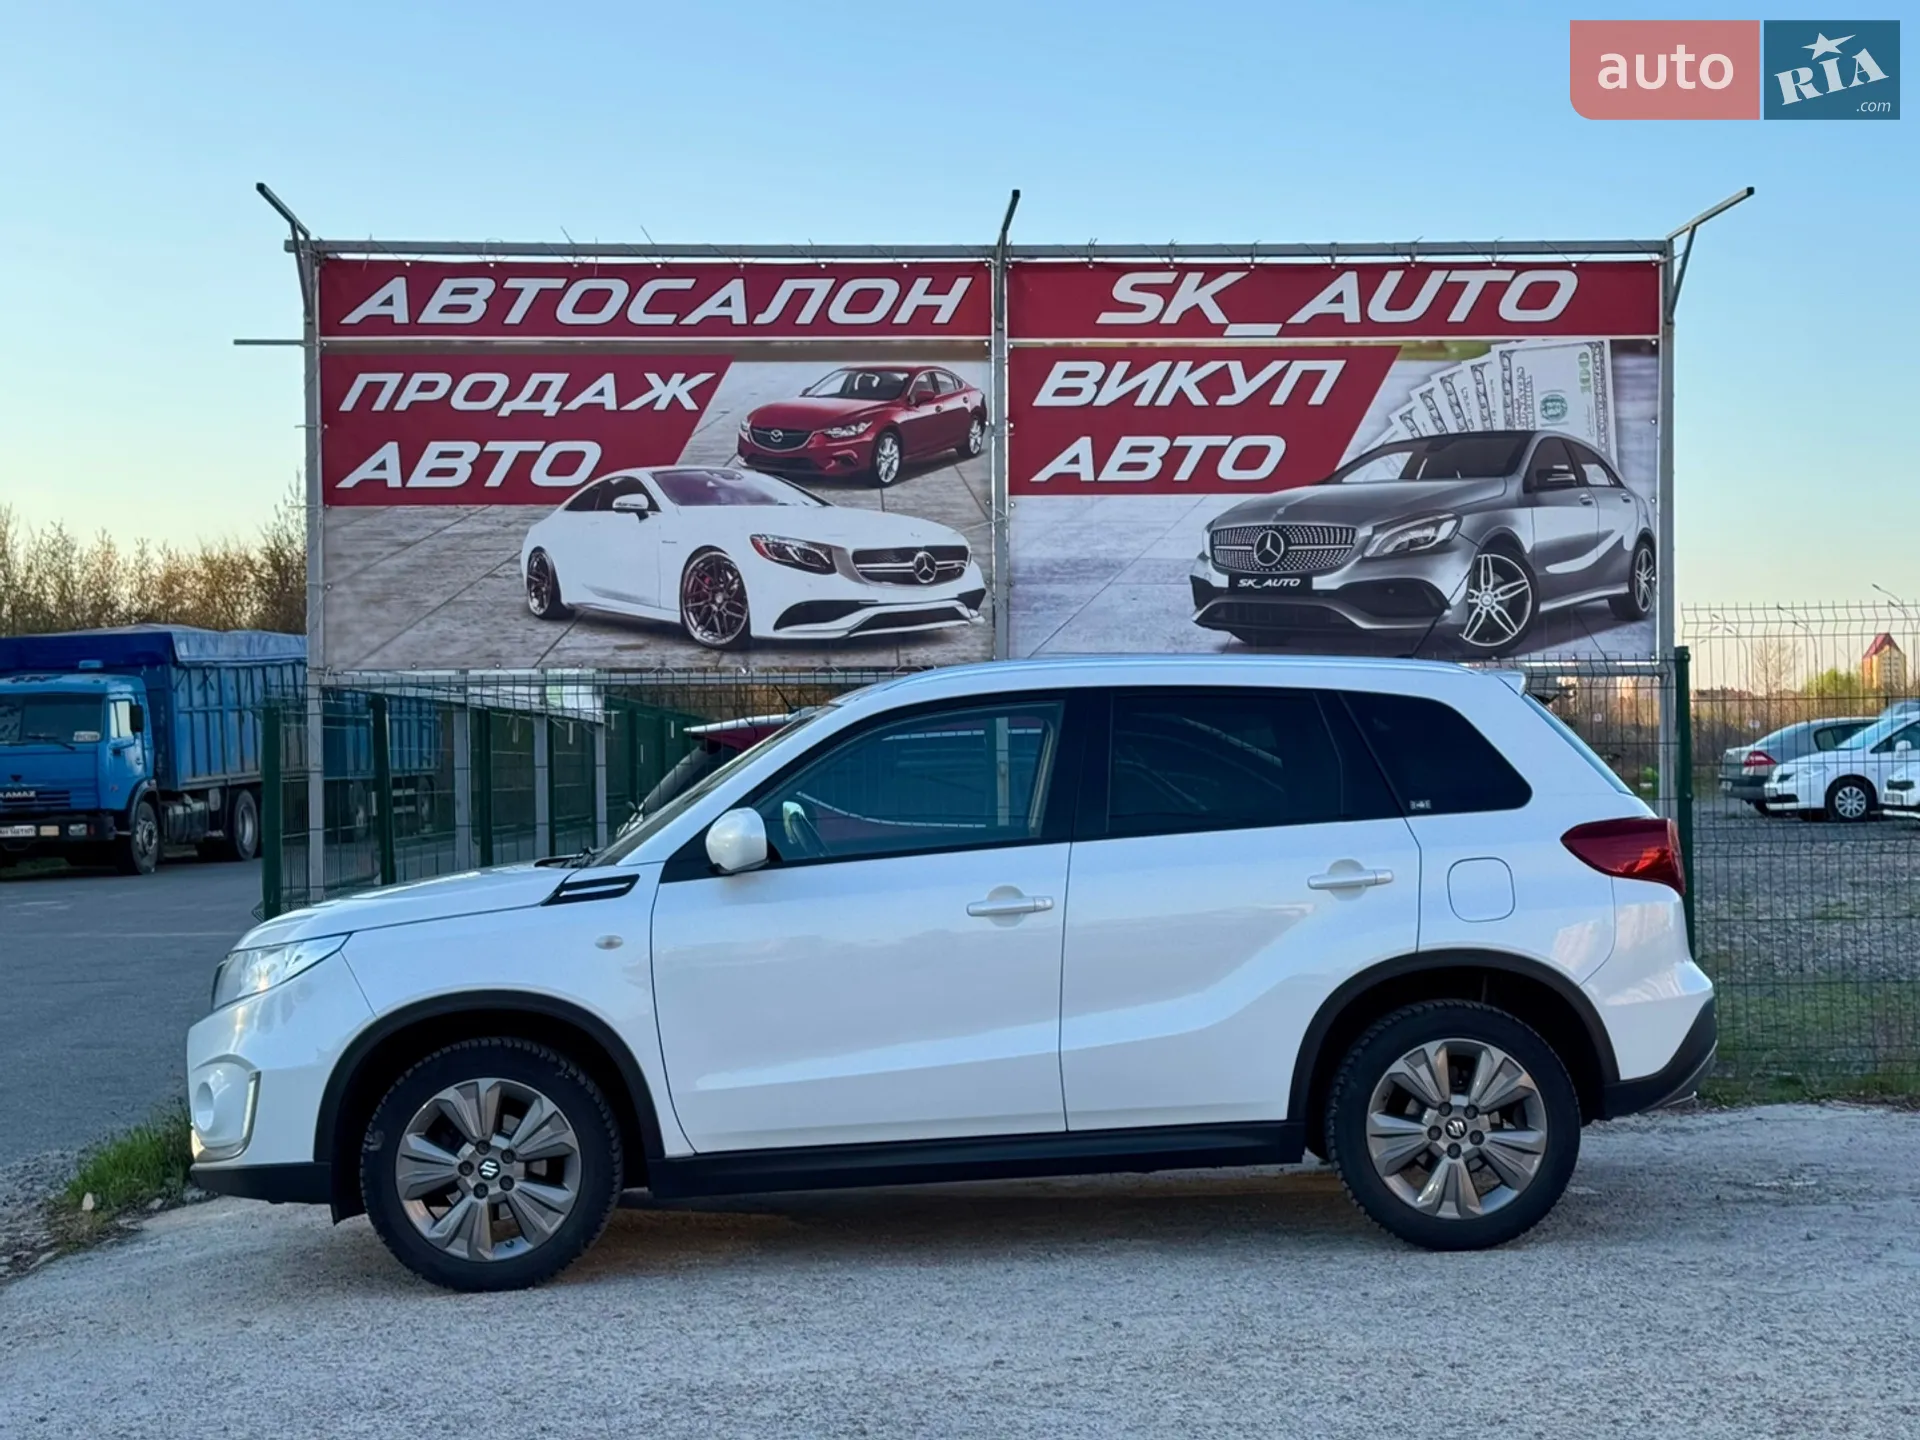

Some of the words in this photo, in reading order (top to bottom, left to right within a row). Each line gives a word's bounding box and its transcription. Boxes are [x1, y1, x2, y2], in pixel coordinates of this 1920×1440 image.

[340, 276, 973, 326] АВТОСАЛОН
[1096, 269, 1579, 337] SK_AUTO
[338, 371, 716, 418] ПРОДАЖ
[1032, 359, 1347, 408] ВИКУП
[335, 440, 603, 489] АВТО
[1031, 434, 1288, 483] АВТО
[1237, 578, 1301, 589] SK_AUTO
